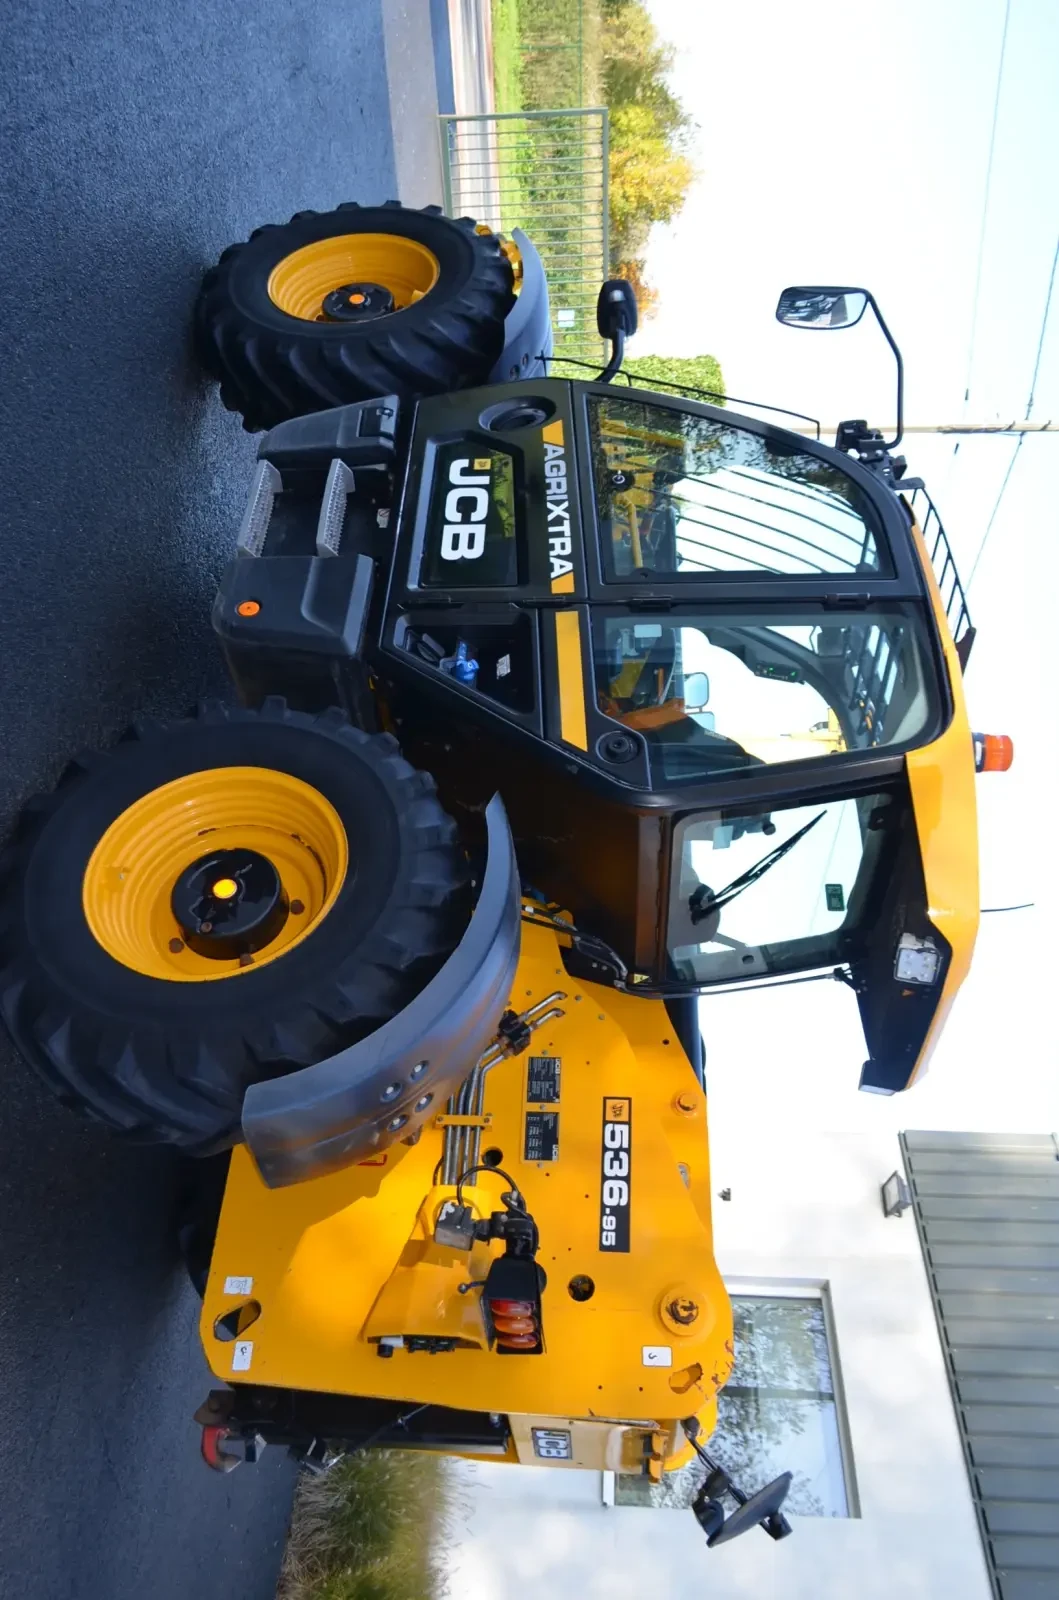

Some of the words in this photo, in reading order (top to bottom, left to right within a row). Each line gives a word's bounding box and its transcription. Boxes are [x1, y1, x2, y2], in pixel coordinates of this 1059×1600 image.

[440, 458, 490, 561] JCB
[543, 443, 573, 578] AGRIXTRA
[536, 1430, 569, 1458] JCB
